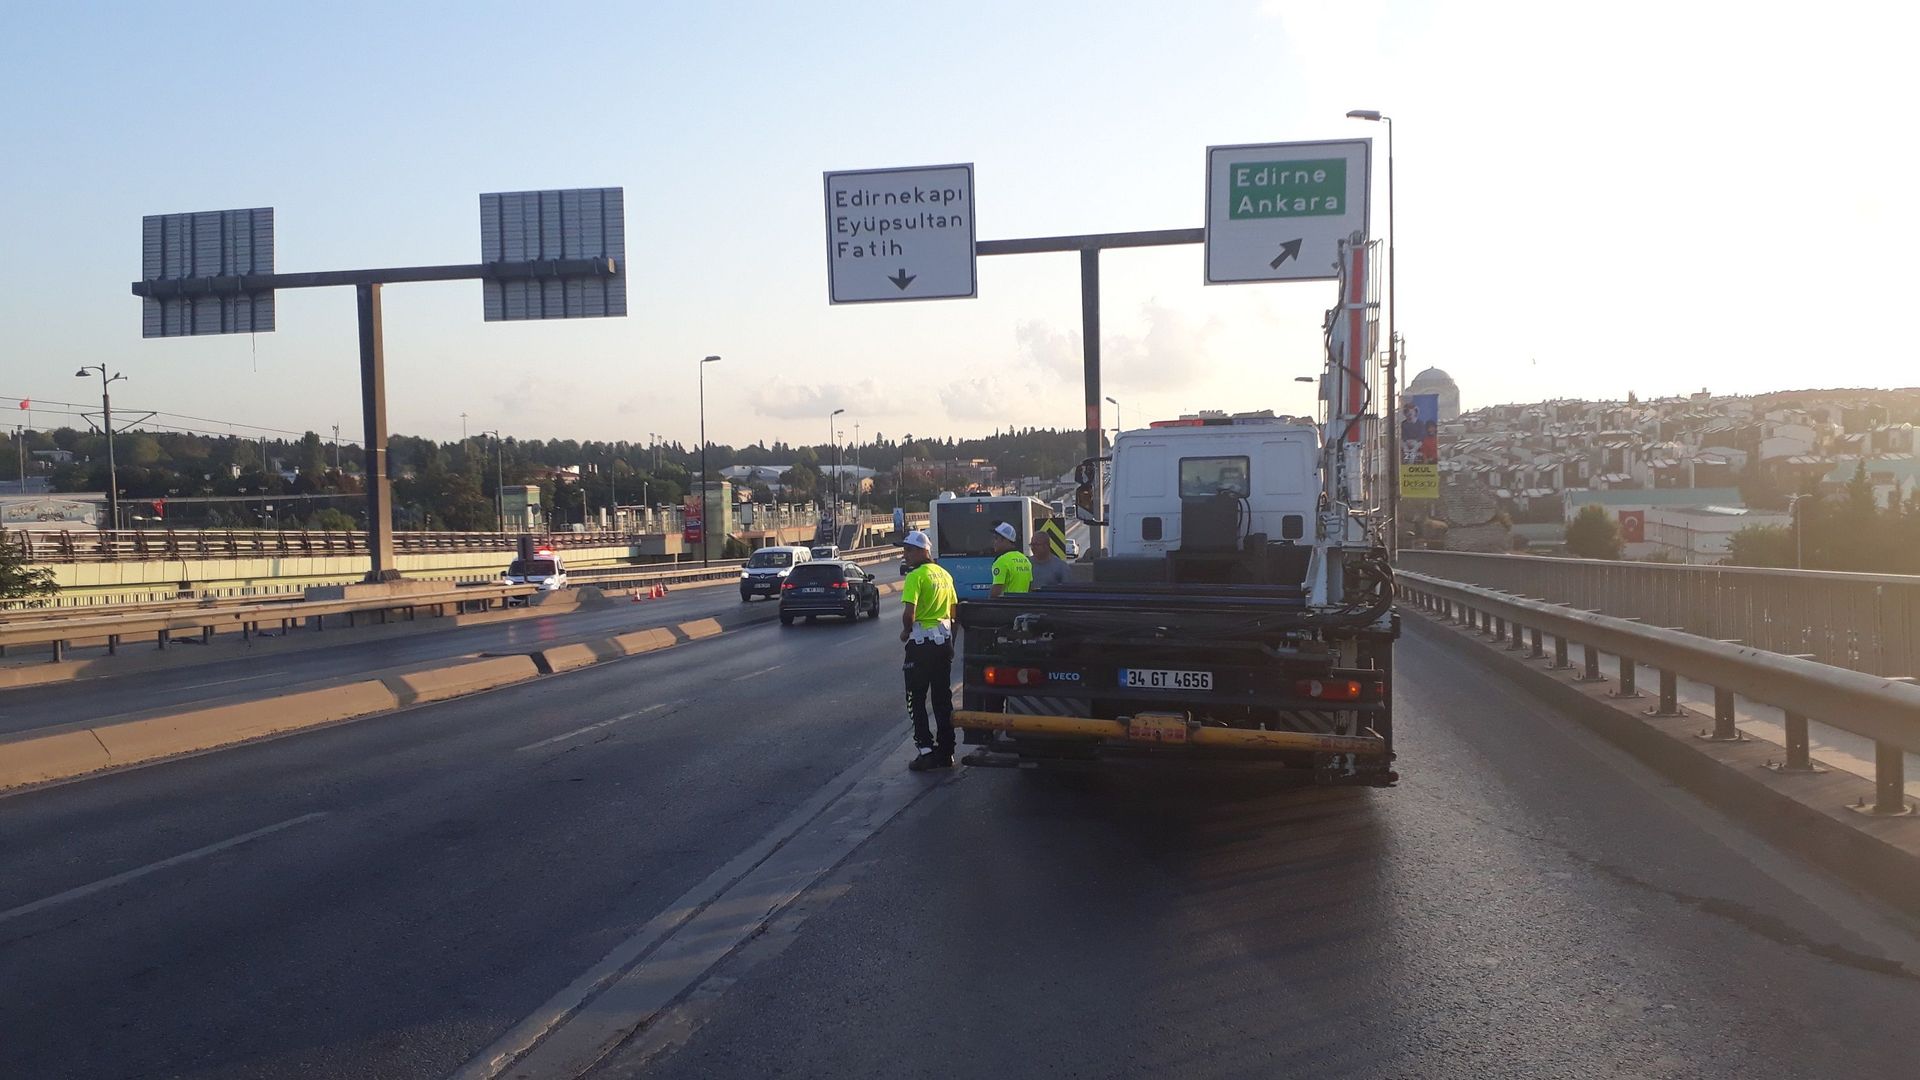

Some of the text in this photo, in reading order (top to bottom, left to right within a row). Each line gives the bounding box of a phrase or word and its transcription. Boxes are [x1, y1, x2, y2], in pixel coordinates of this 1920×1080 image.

[1237, 167, 1326, 187] Edirne
[835, 186, 962, 208] Edirnekapı
[1237, 193, 1338, 214] Ankara
[837, 212, 962, 237] Eyüpsultan
[838, 240, 903, 258] Fatih
[1049, 672, 1080, 681] IVECO
[1129, 671, 1209, 688] 34 GT 4656
